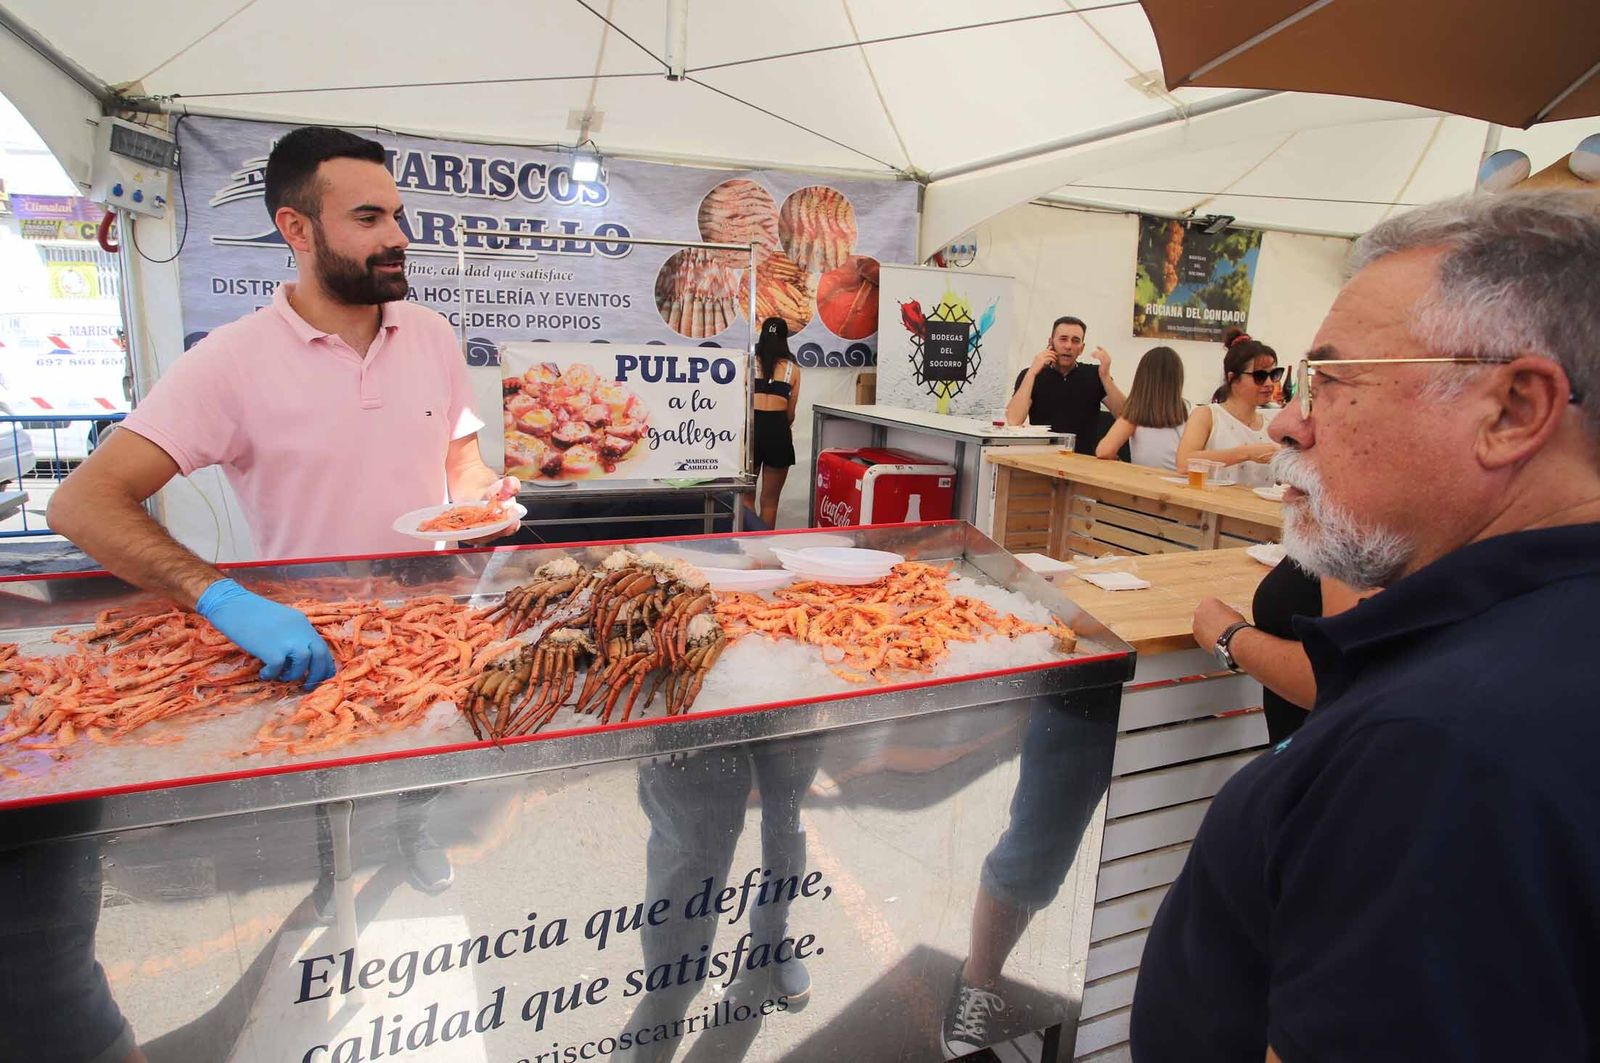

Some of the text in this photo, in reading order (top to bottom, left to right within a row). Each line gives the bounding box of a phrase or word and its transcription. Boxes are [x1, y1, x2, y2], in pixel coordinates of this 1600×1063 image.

[385, 150, 608, 204] ARISCOS
[408, 261, 574, 283] fine, caldad que satisface
[424, 287, 535, 305] HOSTELERÍA
[540, 291, 550, 305] Y
[555, 292, 631, 308] EVENTOS
[526, 314, 601, 330] PROPIOS
[1145, 303, 1246, 322] ROCIANA DEL CONDADO
[931, 333, 963, 342] BODEGAS
[940, 347, 953, 355] DEL
[615, 354, 737, 385] PULPO
[929, 360, 962, 368] SOCORRO
[668, 389, 717, 412] a la
[647, 419, 737, 450] gallega
[293, 867, 834, 1004] Elegancia que define,
[302, 933, 825, 1063] calidad que satisface.
